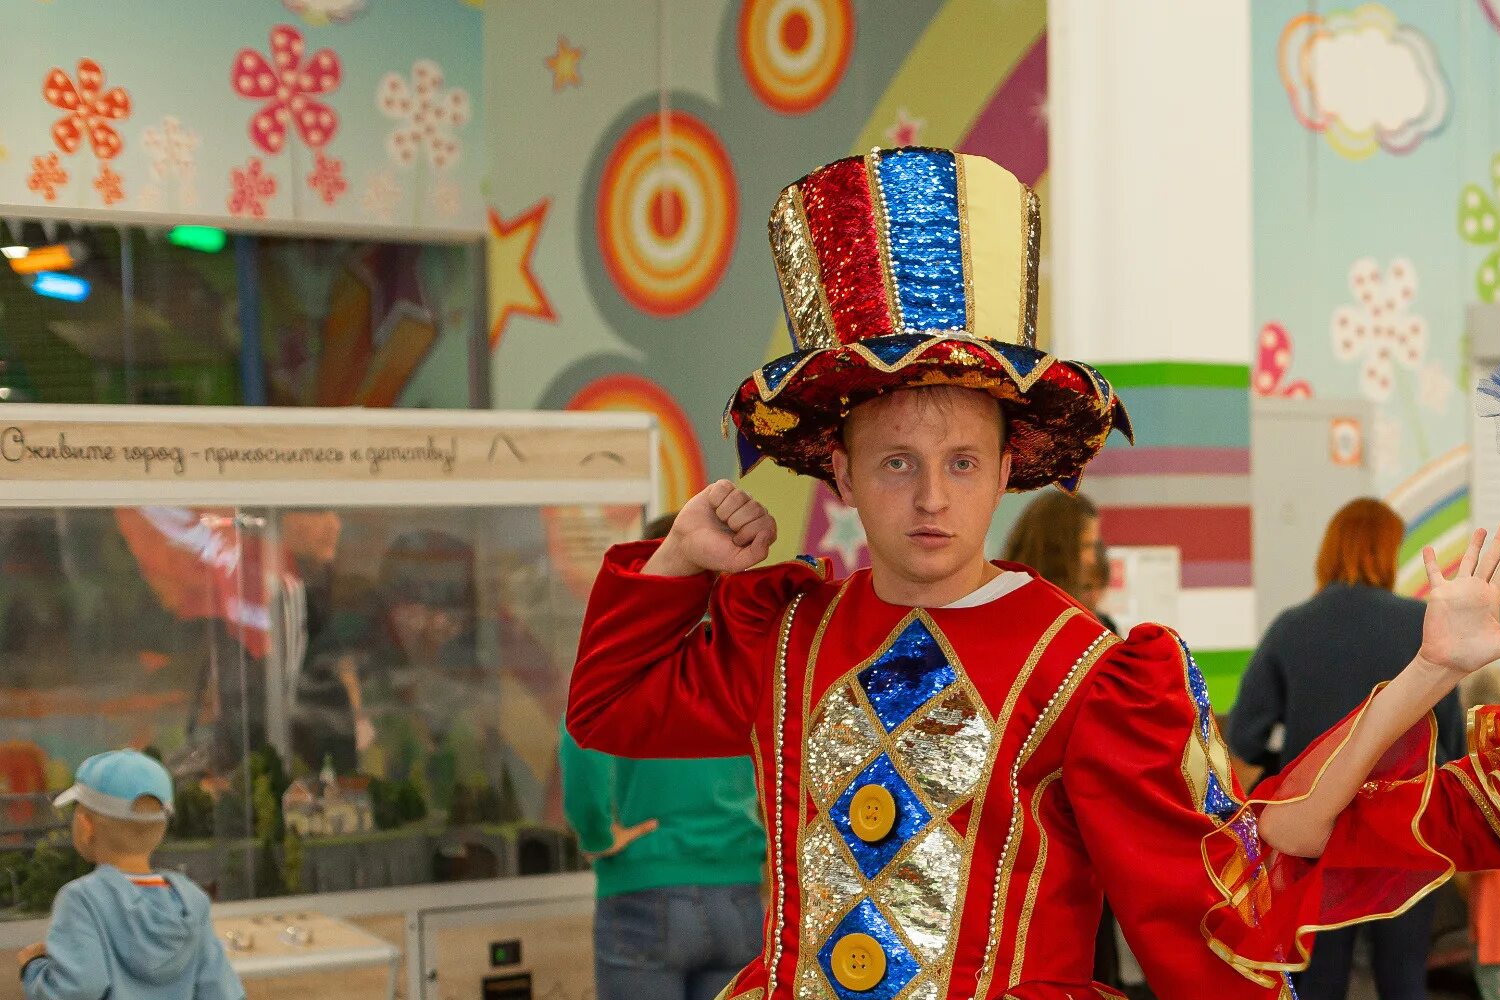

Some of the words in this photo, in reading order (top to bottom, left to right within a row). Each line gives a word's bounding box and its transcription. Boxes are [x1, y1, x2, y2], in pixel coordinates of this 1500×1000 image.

[1, 426, 116, 462] Оживите
[122, 446, 186, 475] город
[204, 446, 344, 475] прикоснитесь
